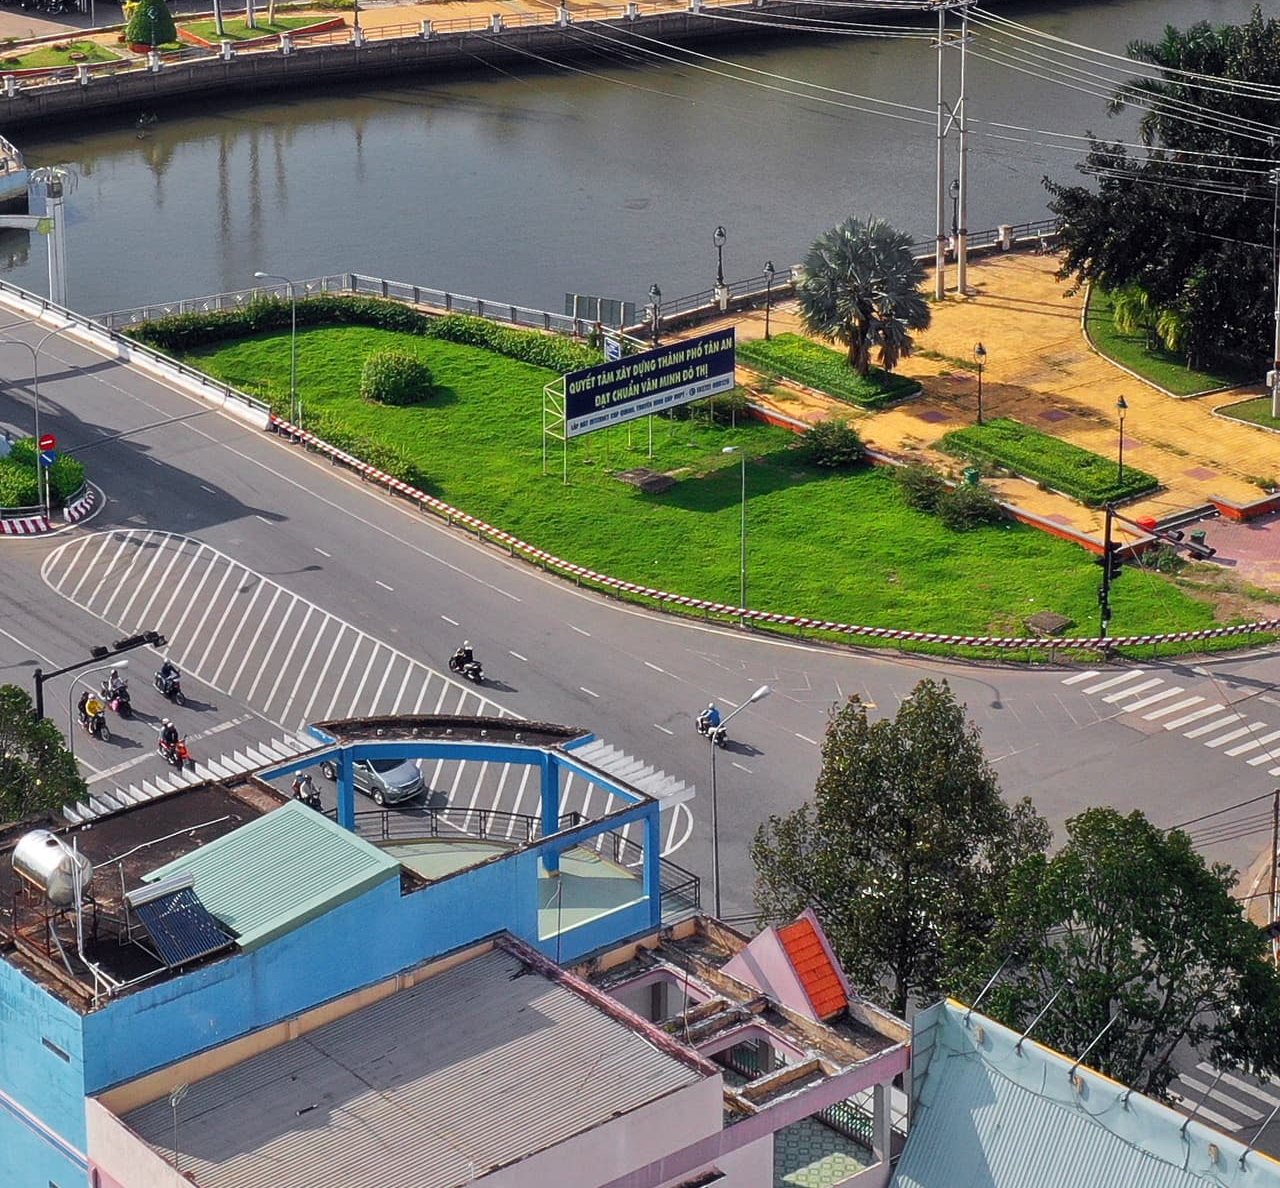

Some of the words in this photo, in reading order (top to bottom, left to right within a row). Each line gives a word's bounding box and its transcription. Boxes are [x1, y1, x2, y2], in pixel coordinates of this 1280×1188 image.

[569, 372, 596, 394] QUYẾT
[597, 370, 615, 386] TÂM
[616, 364, 632, 381] XÂY
[633, 359, 656, 377] DỰNG
[657, 351, 685, 369] THÀNH
[687, 340, 703, 361] PHỐ
[704, 340, 720, 356] TÂN
[721, 336, 733, 350] AN
[595, 392, 611, 408] ĐẠT
[660, 371, 681, 388] MINH
[682, 365, 695, 381] ĐÔ
[696, 363, 709, 378] THỊ
